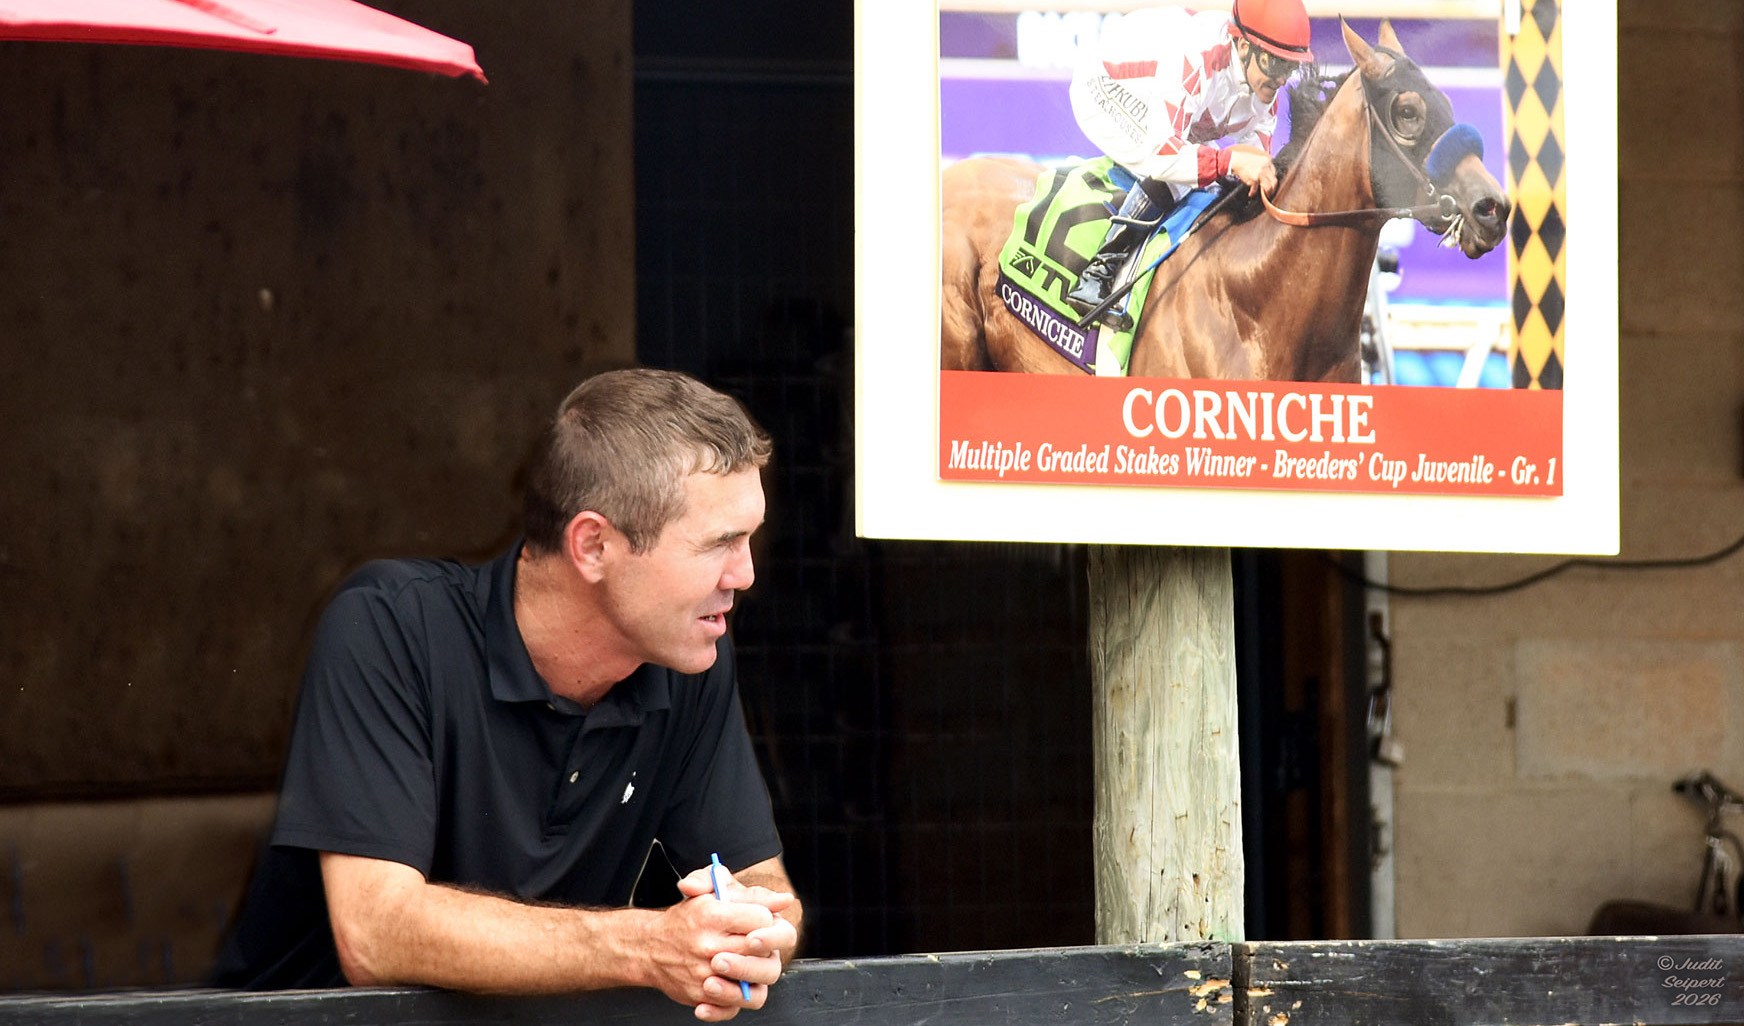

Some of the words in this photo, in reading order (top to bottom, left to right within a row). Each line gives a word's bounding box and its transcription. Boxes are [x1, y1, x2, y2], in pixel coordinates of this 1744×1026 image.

[1001, 283, 1085, 359] CORNICHE
[1122, 387, 1376, 444] CORNICHE
[948, 440, 1032, 478] Multiple
[1037, 442, 1111, 473] Graded
[1114, 444, 1180, 476] Stakes
[1185, 446, 1257, 478] Winner
[1272, 449, 1365, 481] Breeders’
[1368, 451, 1408, 488] Cup
[1411, 453, 1494, 484] Juvenile
[1510, 456, 1540, 485] Gr.
[1546, 457, 1557, 485] 1
